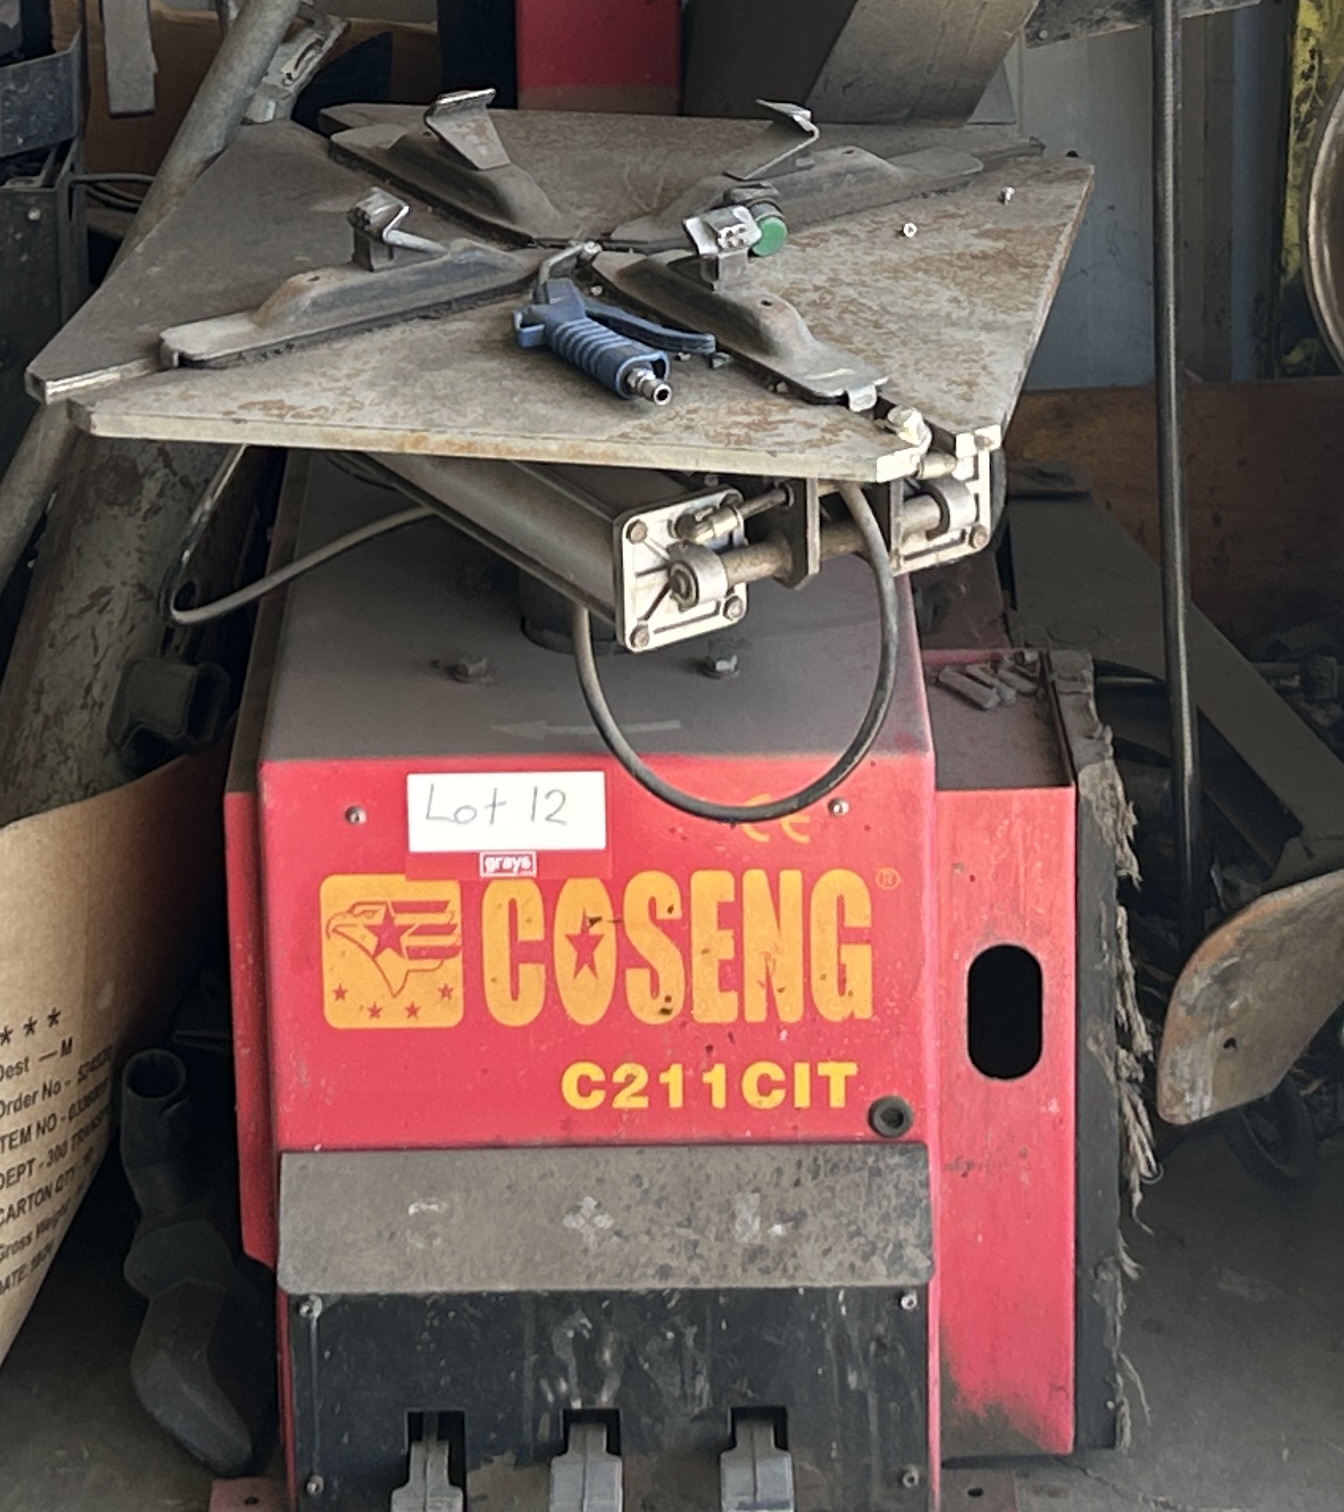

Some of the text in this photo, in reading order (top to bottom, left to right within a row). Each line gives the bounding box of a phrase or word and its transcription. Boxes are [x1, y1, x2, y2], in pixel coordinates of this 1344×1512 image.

[425, 783, 567, 826] Lot 12
[485, 856, 531, 874] grays
[482, 869, 873, 1025] COSENG
[42, 1080, 62, 1101] No
[561, 1061, 857, 1110] C211CIT
[36, 1113, 57, 1139] NO
